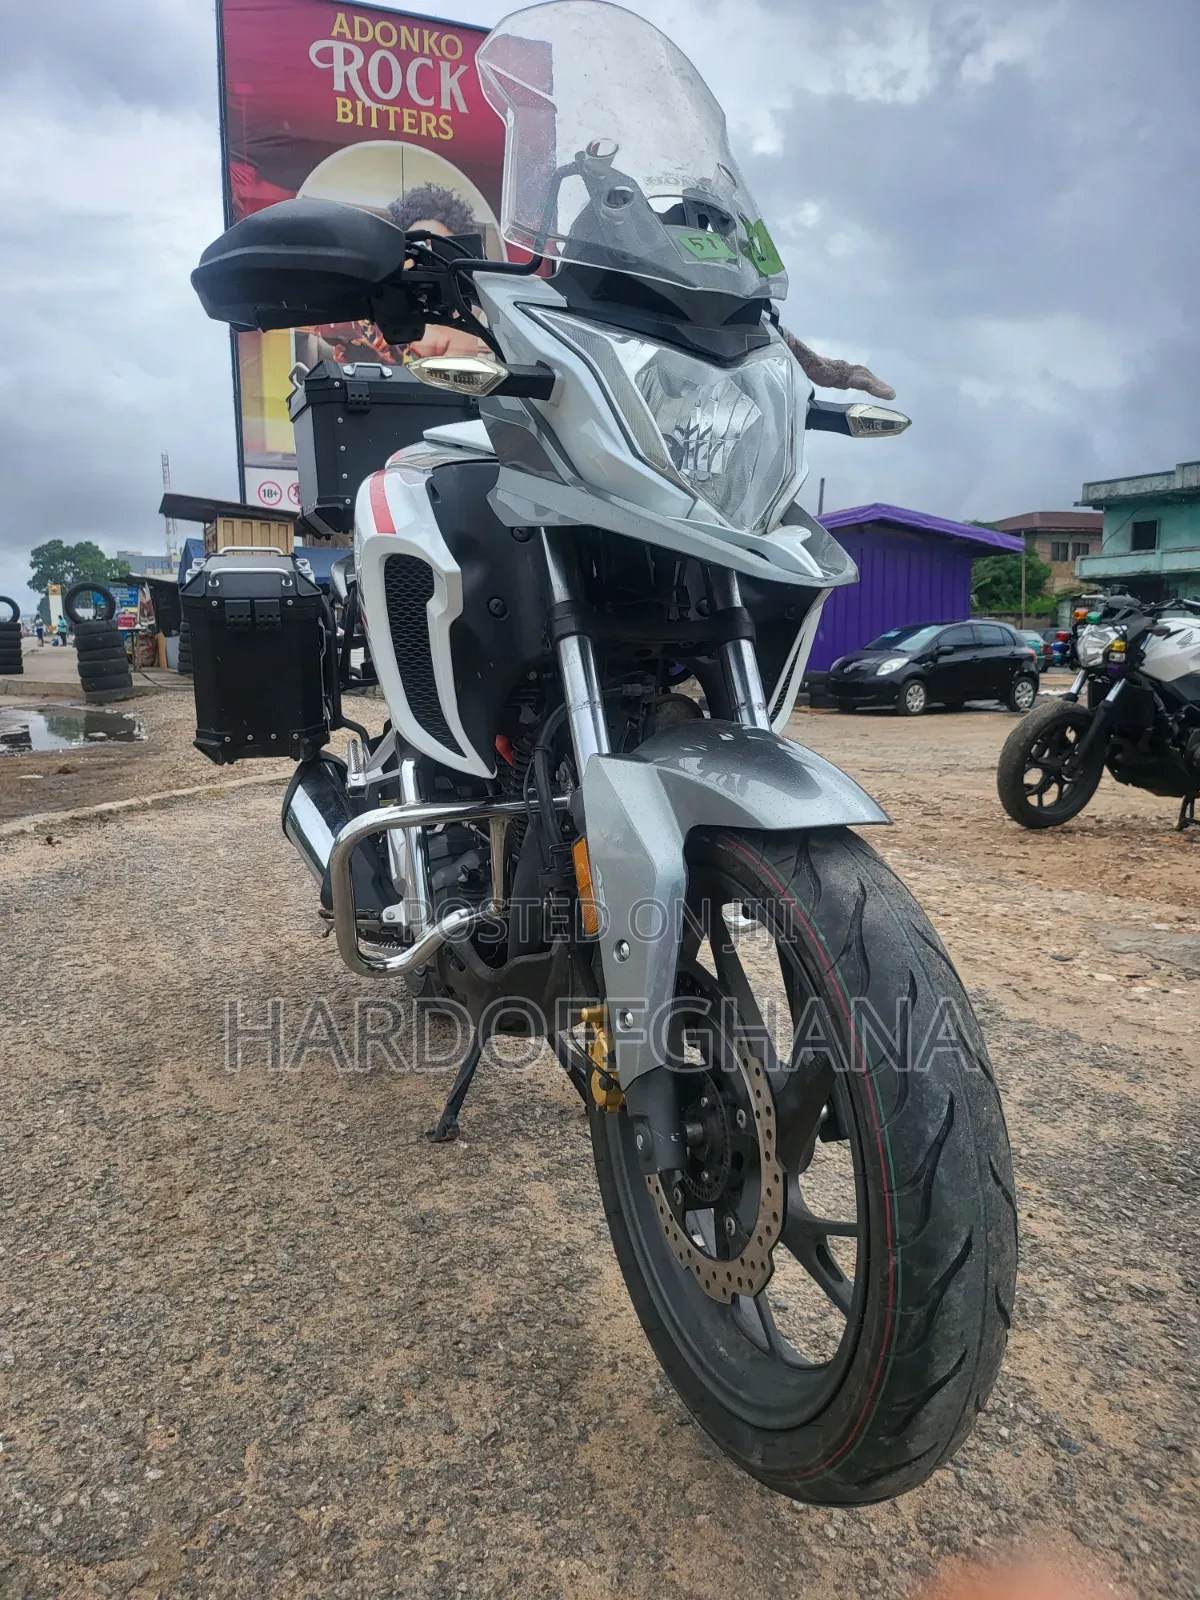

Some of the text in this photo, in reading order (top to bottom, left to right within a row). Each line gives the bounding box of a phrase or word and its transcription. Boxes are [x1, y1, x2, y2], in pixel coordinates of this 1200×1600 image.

[331, 12, 463, 60] ADONKO
[309, 39, 469, 114] ROCK
[336, 97, 454, 140] BITTERS
[262, 488, 279, 499] 18+
